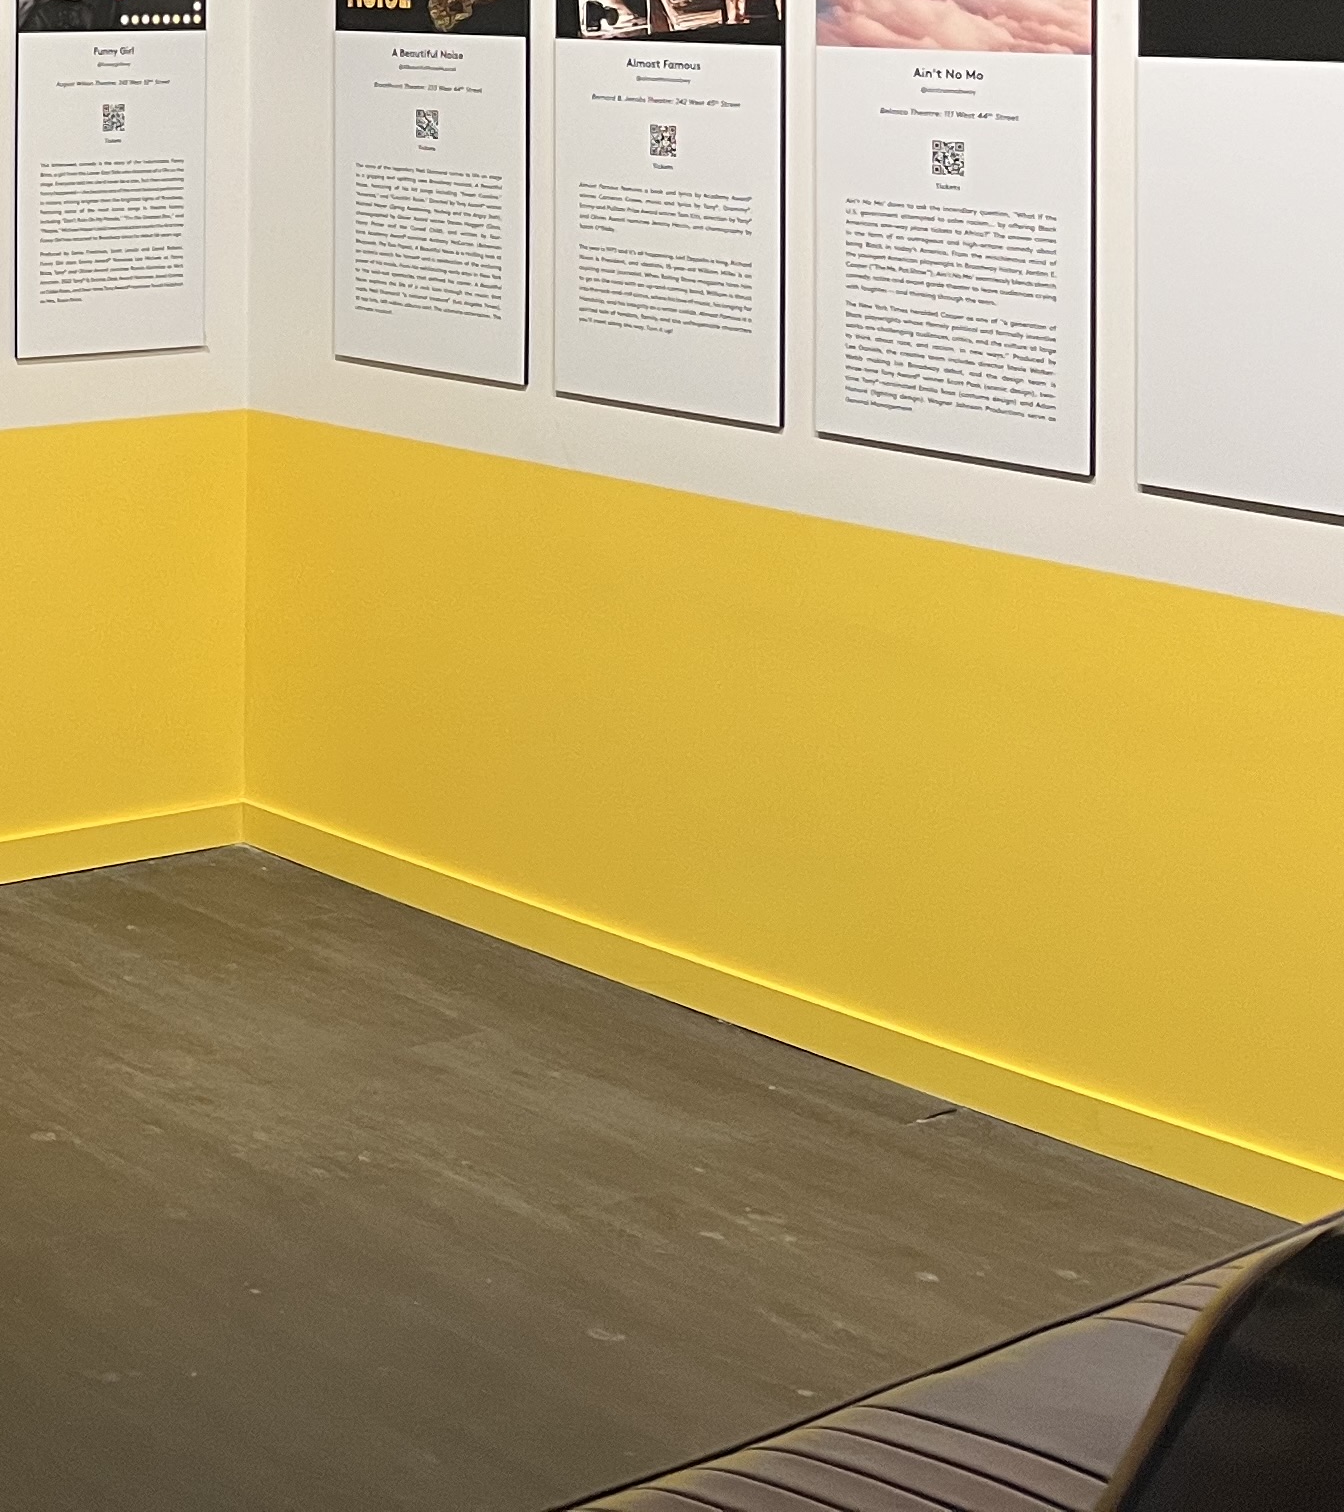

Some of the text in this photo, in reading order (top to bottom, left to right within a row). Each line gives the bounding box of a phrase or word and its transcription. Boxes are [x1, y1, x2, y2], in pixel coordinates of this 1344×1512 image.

[94, 46, 135, 57] Funny Girl
[392, 48, 464, 60] A Beautiful Noise
[626, 58, 701, 71] Almost Famous
[913, 67, 984, 81] Ain't No Mo
[956, 110, 975, 119] West
[995, 113, 1019, 122] Street
